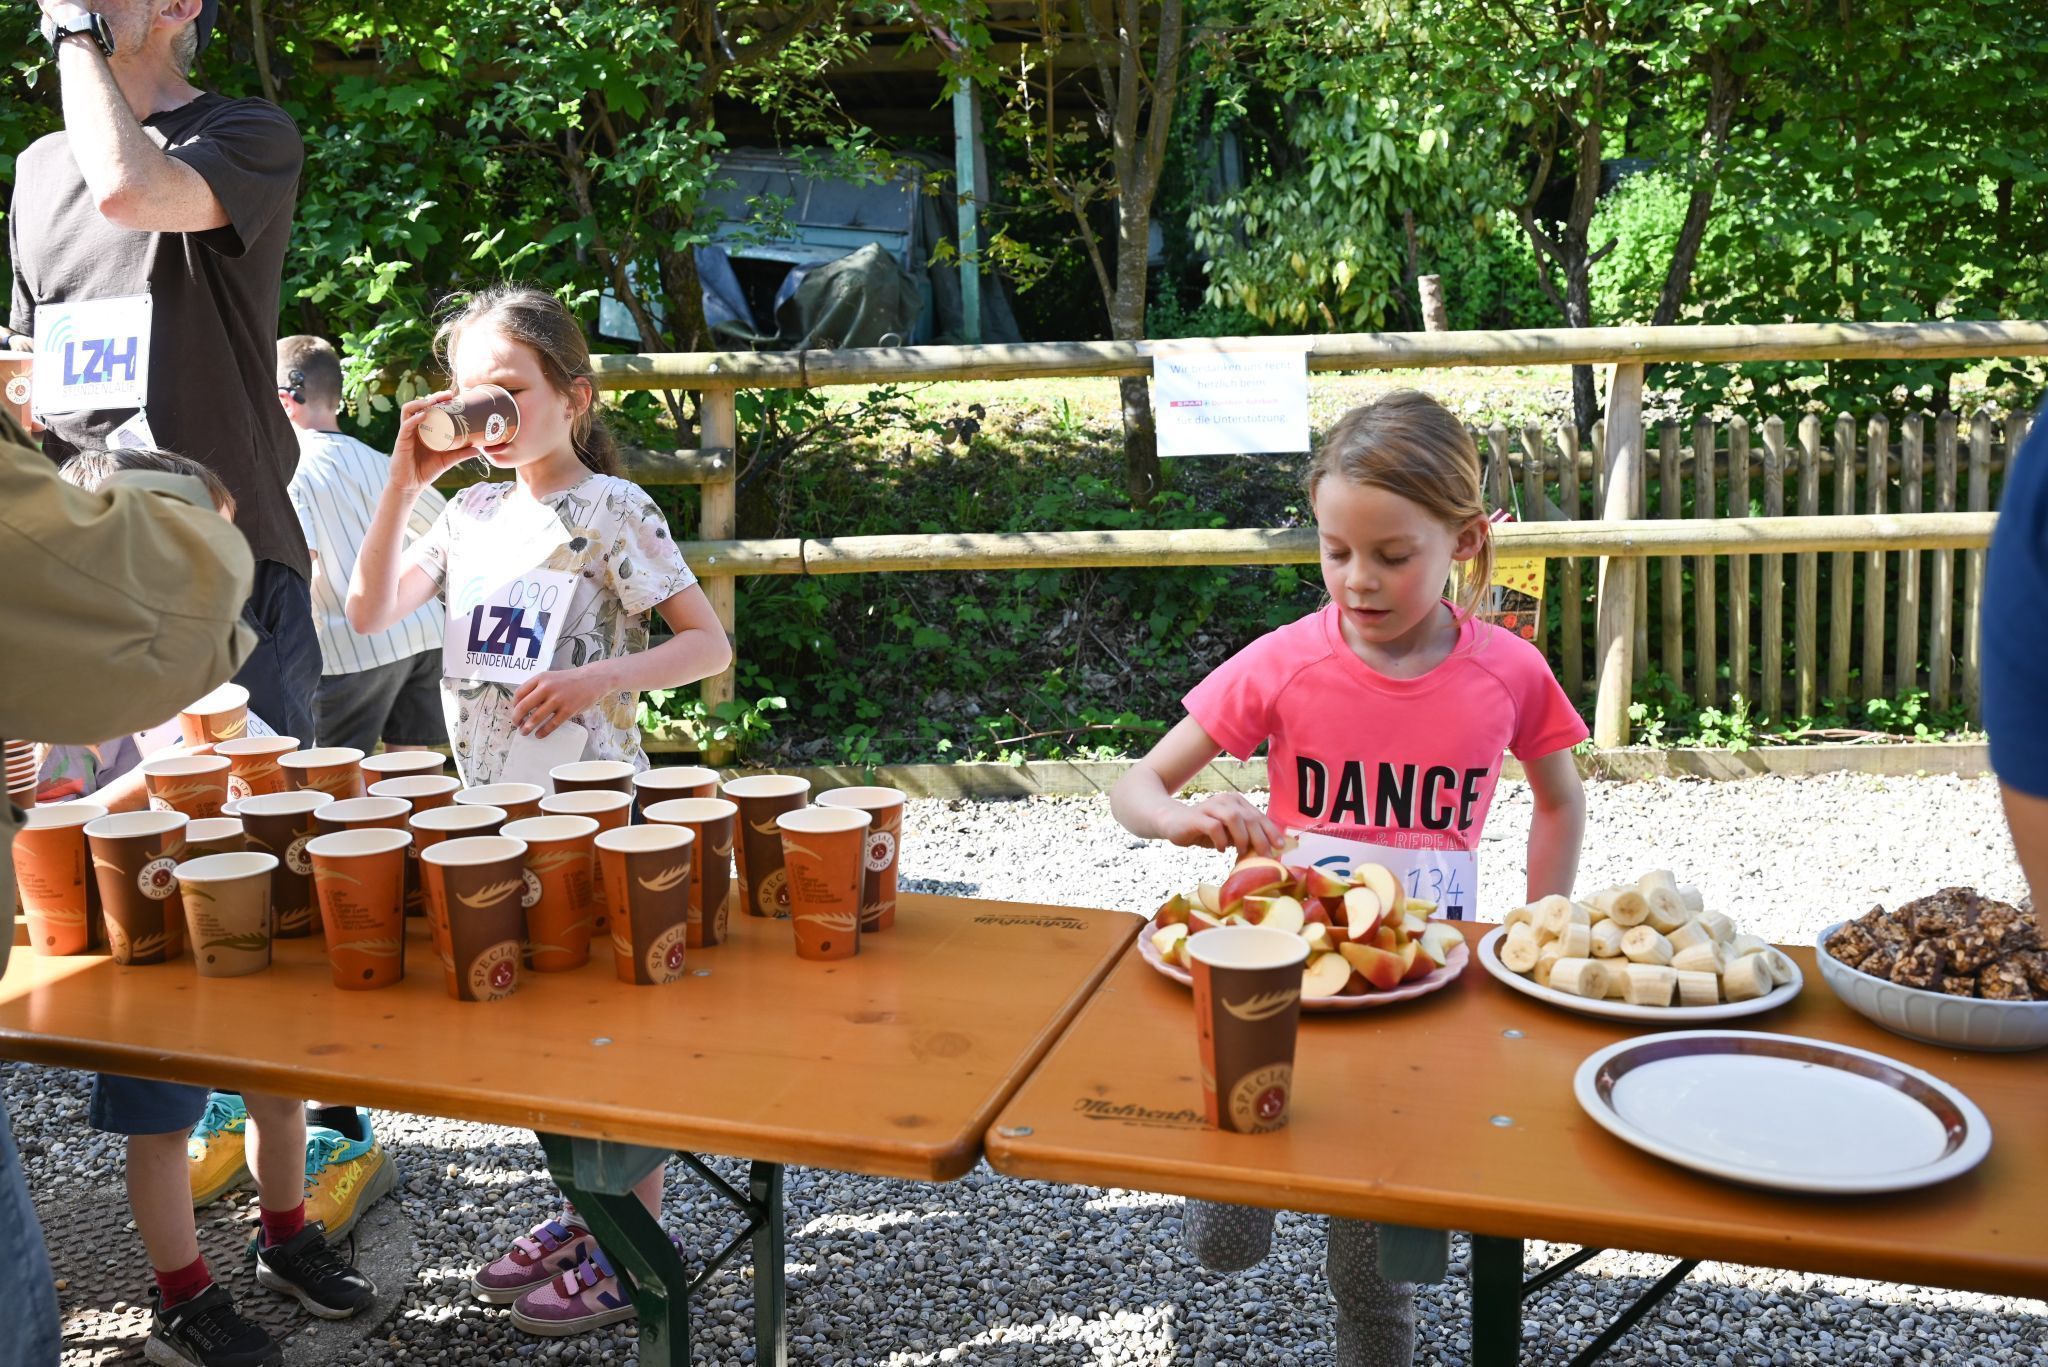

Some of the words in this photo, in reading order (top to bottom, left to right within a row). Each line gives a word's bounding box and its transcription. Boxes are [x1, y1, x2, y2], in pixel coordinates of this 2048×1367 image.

[63, 336, 138, 386] LZH
[1195, 415, 1211, 425] die
[508, 580, 559, 612] 090
[467, 605, 552, 659] LZH
[466, 651, 538, 671] STUNDENLAUF
[1296, 755, 1490, 831] DANCE
[1408, 868, 1464, 905] 134
[329, 1160, 363, 1205] HOKA
